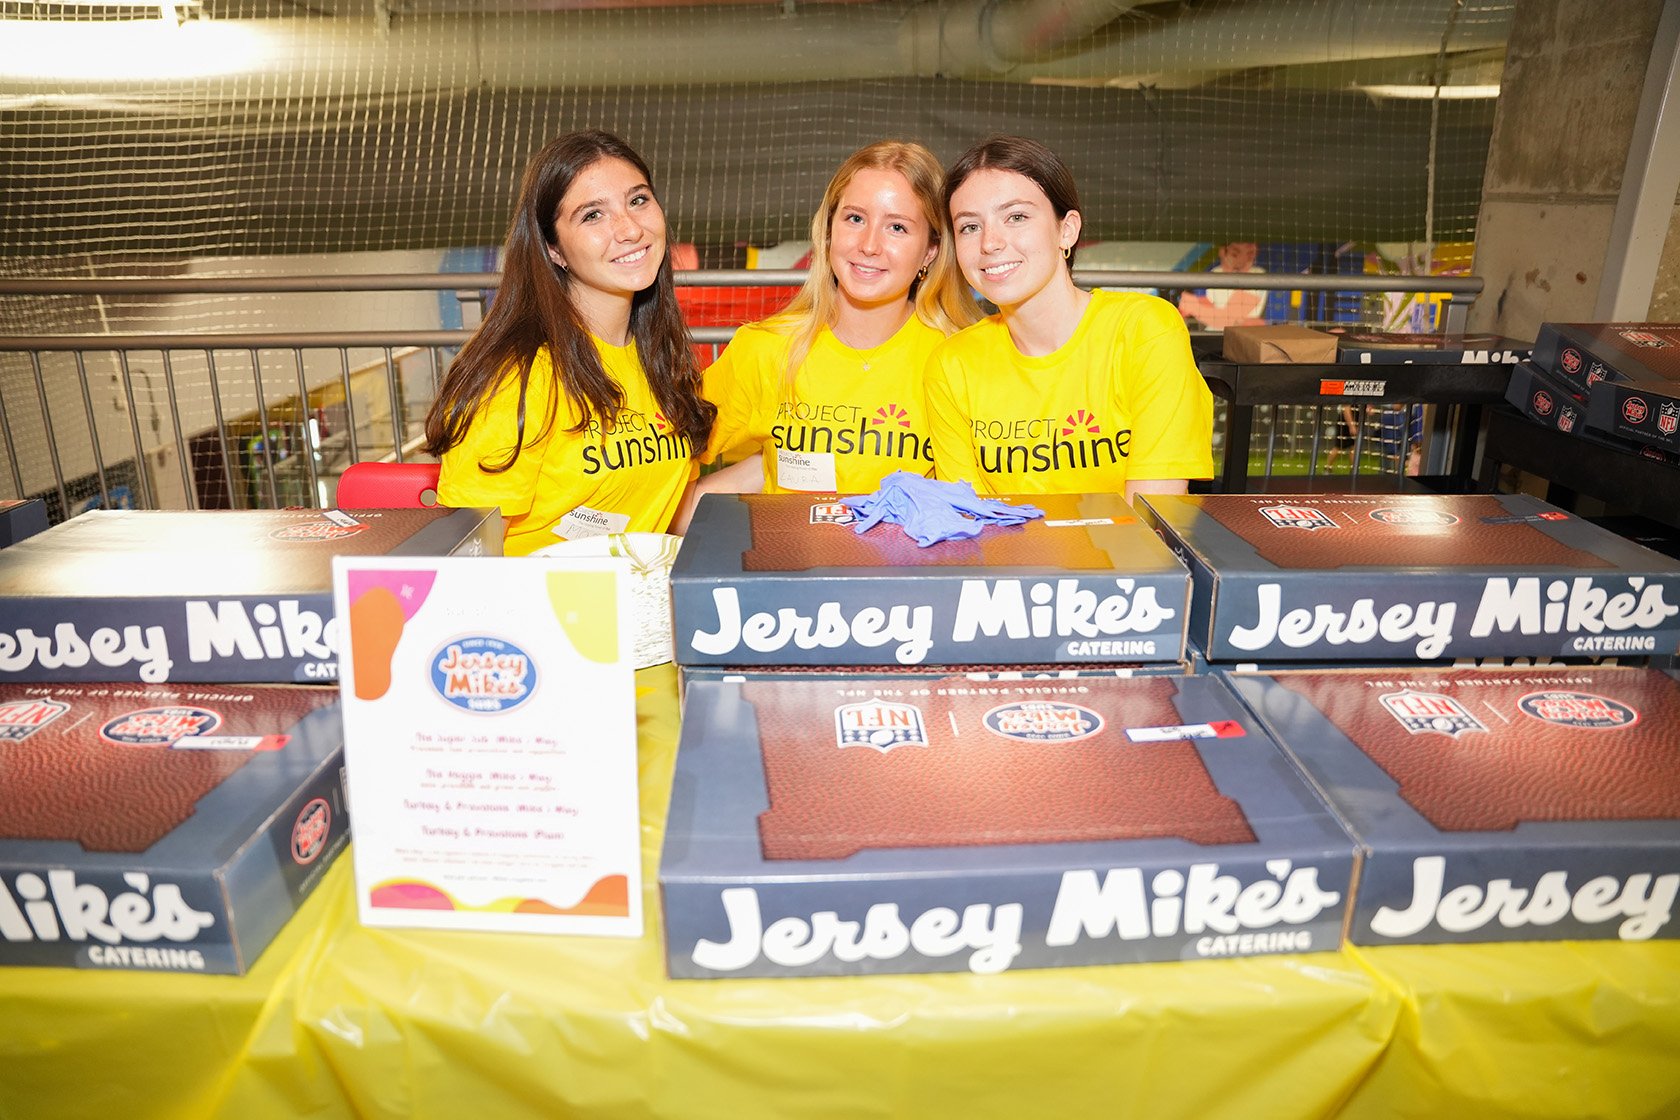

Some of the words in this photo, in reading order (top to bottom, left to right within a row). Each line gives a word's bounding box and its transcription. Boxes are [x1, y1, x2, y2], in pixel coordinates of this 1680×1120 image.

[776, 402, 861, 423] PROJECT
[1559, 416, 1572, 431] NFL
[1660, 415, 1676, 431] NFL
[771, 417, 934, 461] sunshine
[583, 423, 692, 474] sunshin
[974, 428, 1131, 473] unshine
[778, 454, 811, 467] sunshine
[569, 510, 609, 526] sunshine
[1267, 508, 1319, 519] NFL
[691, 587, 934, 665] Jersey
[952, 578, 1175, 643] Mike's
[1228, 583, 1457, 660] Jersey
[1469, 577, 1679, 639] Mike's
[0, 622, 173, 683] ersey
[185, 600, 338, 663] Mik
[1067, 641, 1156, 656] CATERING
[1572, 636, 1655, 651] CATERING
[441, 646, 525, 676] Jersey
[1364, 680, 1394, 688] NFL
[1455, 678, 1520, 686] PARTNER
[1524, 677, 1593, 685] OFFICIAL
[113, 690, 181, 699] PARTNER
[187, 692, 254, 701] OFFICIAL
[873, 689, 904, 697] THE
[910, 688, 931, 696] OF
[937, 687, 1009, 696] PARTNER
[1015, 686, 1089, 694] OFFICIAL
[1391, 696, 1458, 715] NFL
[846, 707, 911, 726] NFL
[445, 801, 452, 811] &
[464, 828, 471, 837] &
[0, 869, 215, 944] ike's
[1370, 856, 1680, 941] Jersey
[691, 887, 1023, 974] Jersey
[1046, 859, 1340, 946] Mike's
[1195, 931, 1311, 956] CATERING
[88, 945, 205, 970] CATERING
